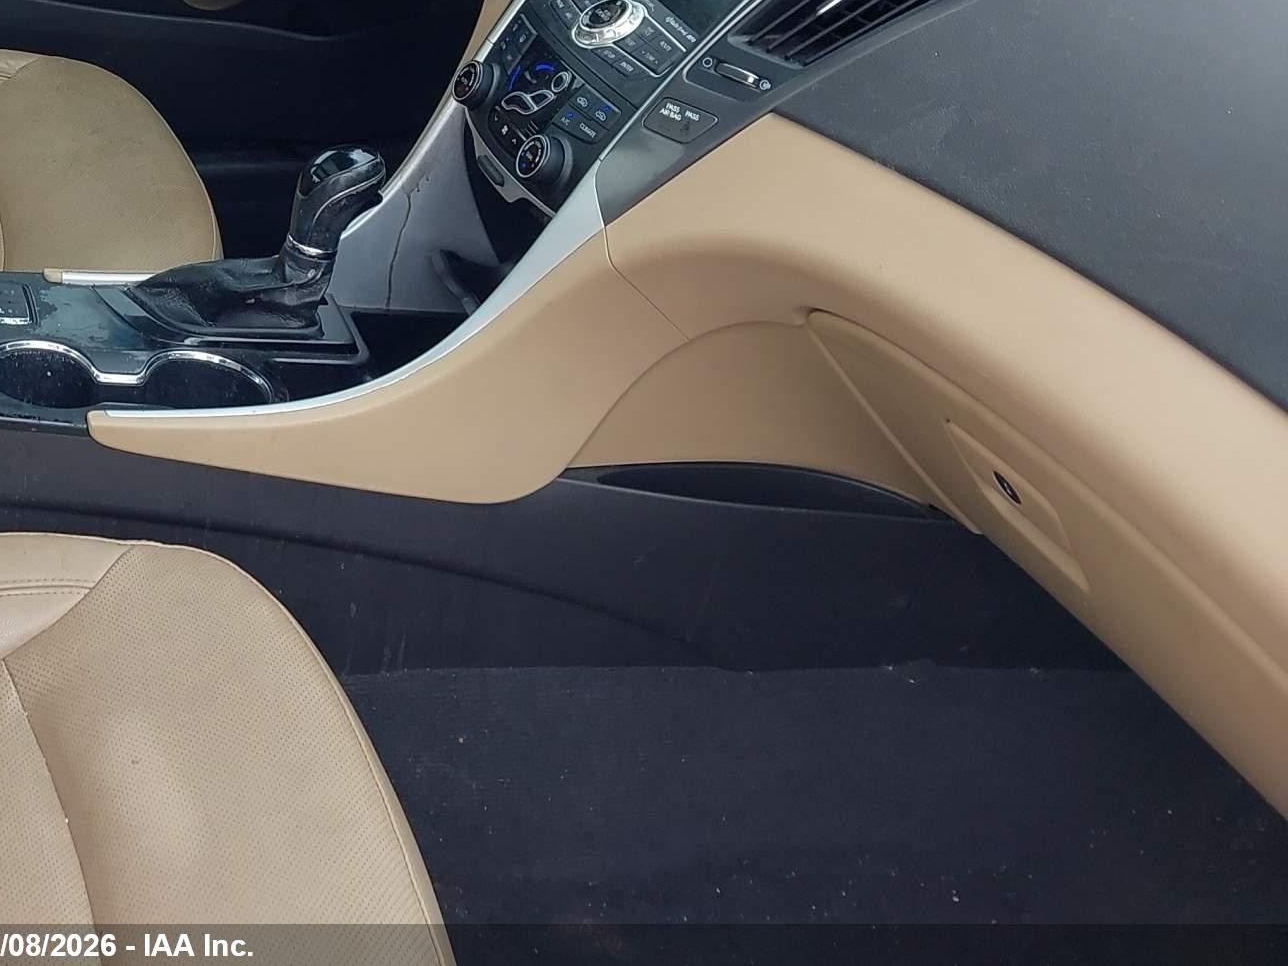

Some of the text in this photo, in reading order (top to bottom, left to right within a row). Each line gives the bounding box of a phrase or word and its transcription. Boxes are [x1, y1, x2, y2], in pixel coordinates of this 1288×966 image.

[665, 102, 681, 114] PASS
[684, 109, 700, 122] PASS
[579, 122, 597, 138] CLIMATE
